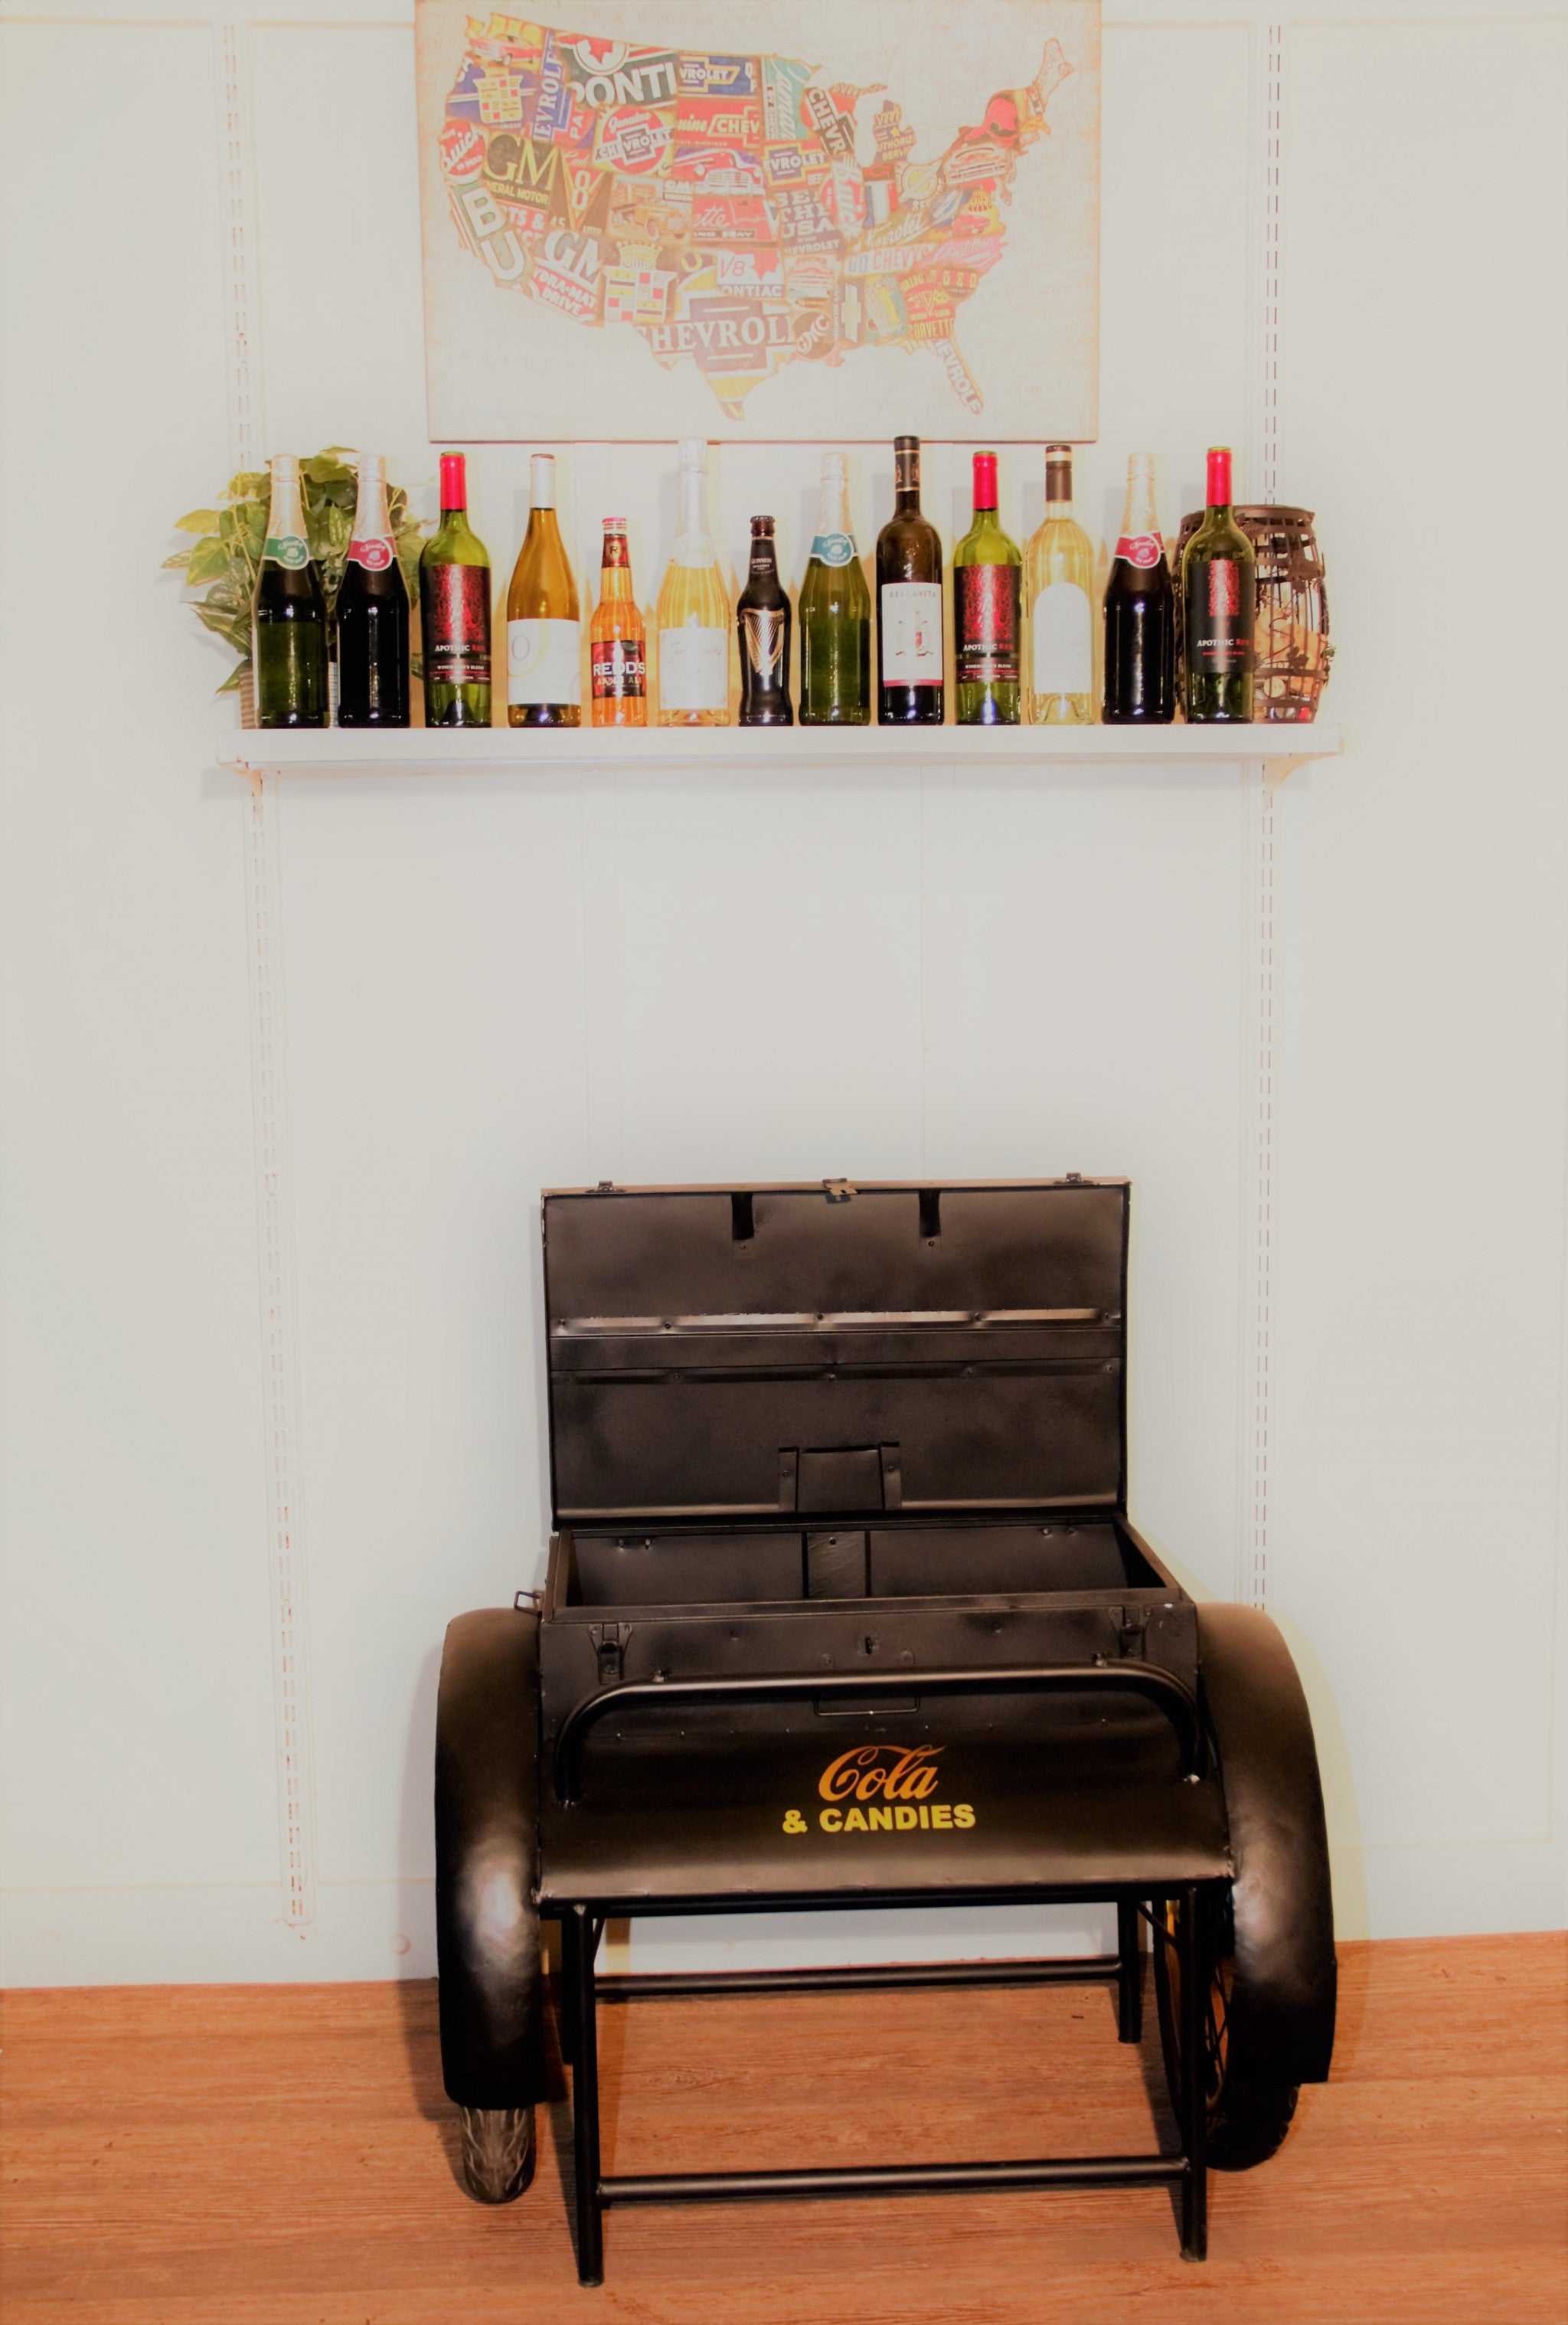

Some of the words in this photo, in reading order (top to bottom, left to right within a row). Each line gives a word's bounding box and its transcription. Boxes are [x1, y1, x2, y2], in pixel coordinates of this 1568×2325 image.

[596, 128, 671, 160] CHEVROLET
[482, 133, 560, 191] GM
[541, 286, 583, 316] DRIVE
[640, 312, 798, 352] HEVROL
[434, 644, 470, 652] APOTIC
[818, 1745, 947, 1802] Cola
[782, 1809, 808, 1834] &
[818, 1803, 976, 1833] CANDIES
